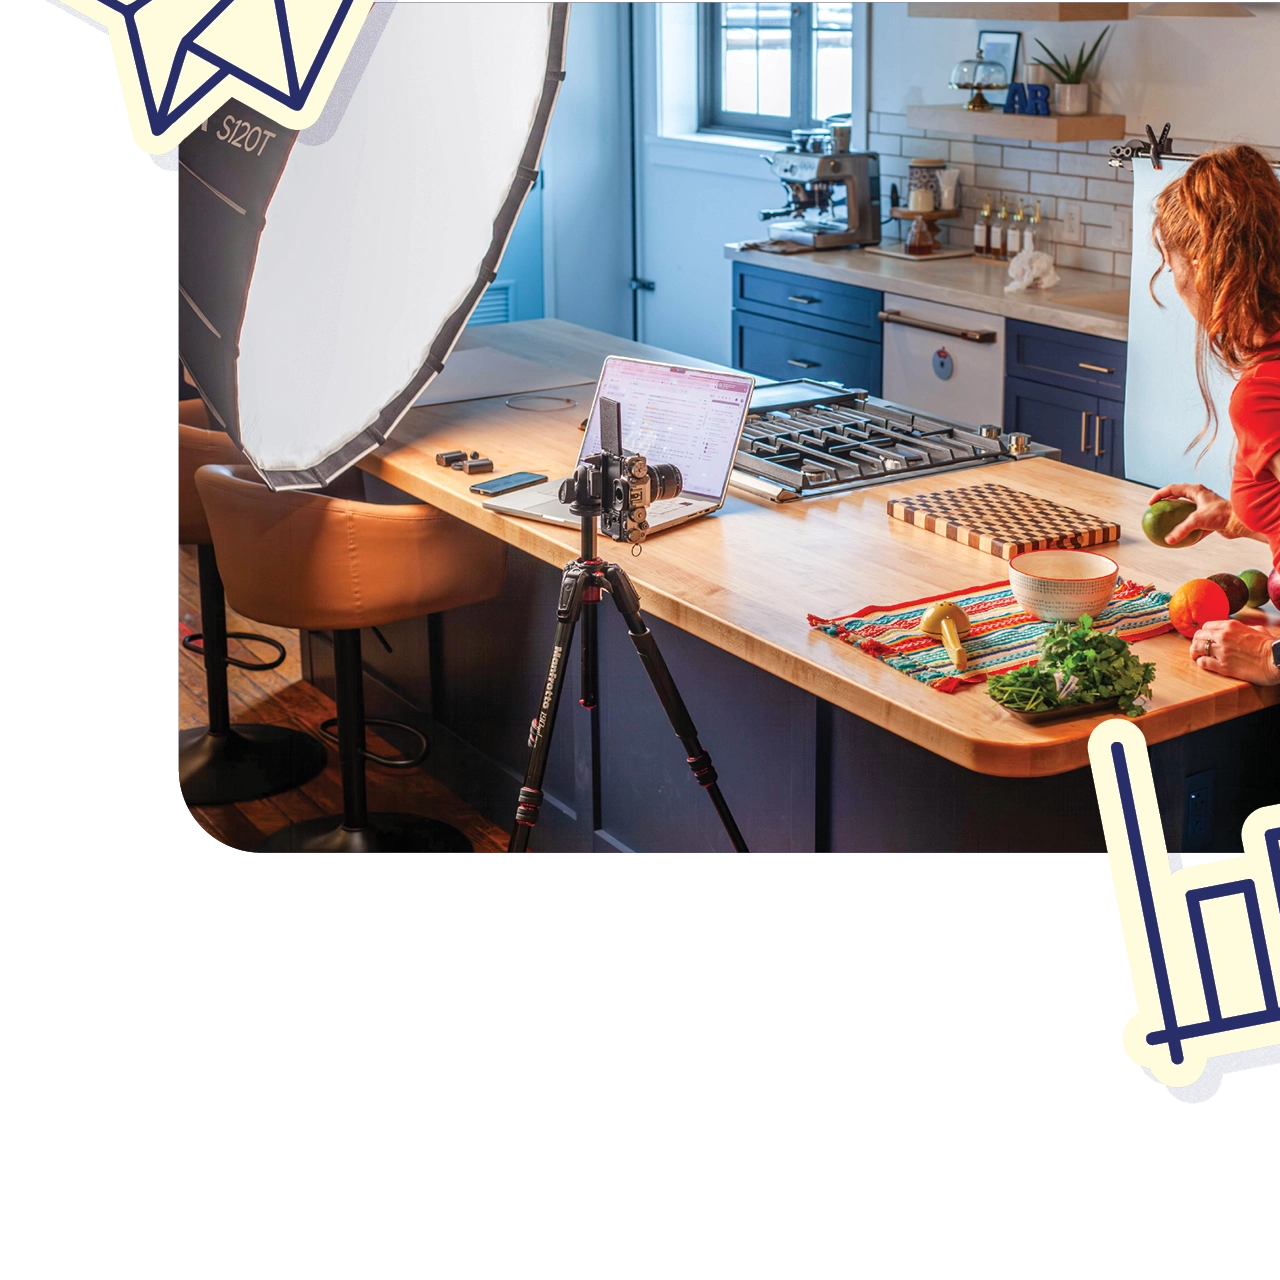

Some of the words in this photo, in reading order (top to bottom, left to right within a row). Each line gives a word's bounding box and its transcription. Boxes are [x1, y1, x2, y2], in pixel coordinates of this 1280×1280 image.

[1003, 82, 1050, 116] AR
[216, 114, 277, 157] S120T
[542, 645, 563, 710] Manfrotto
